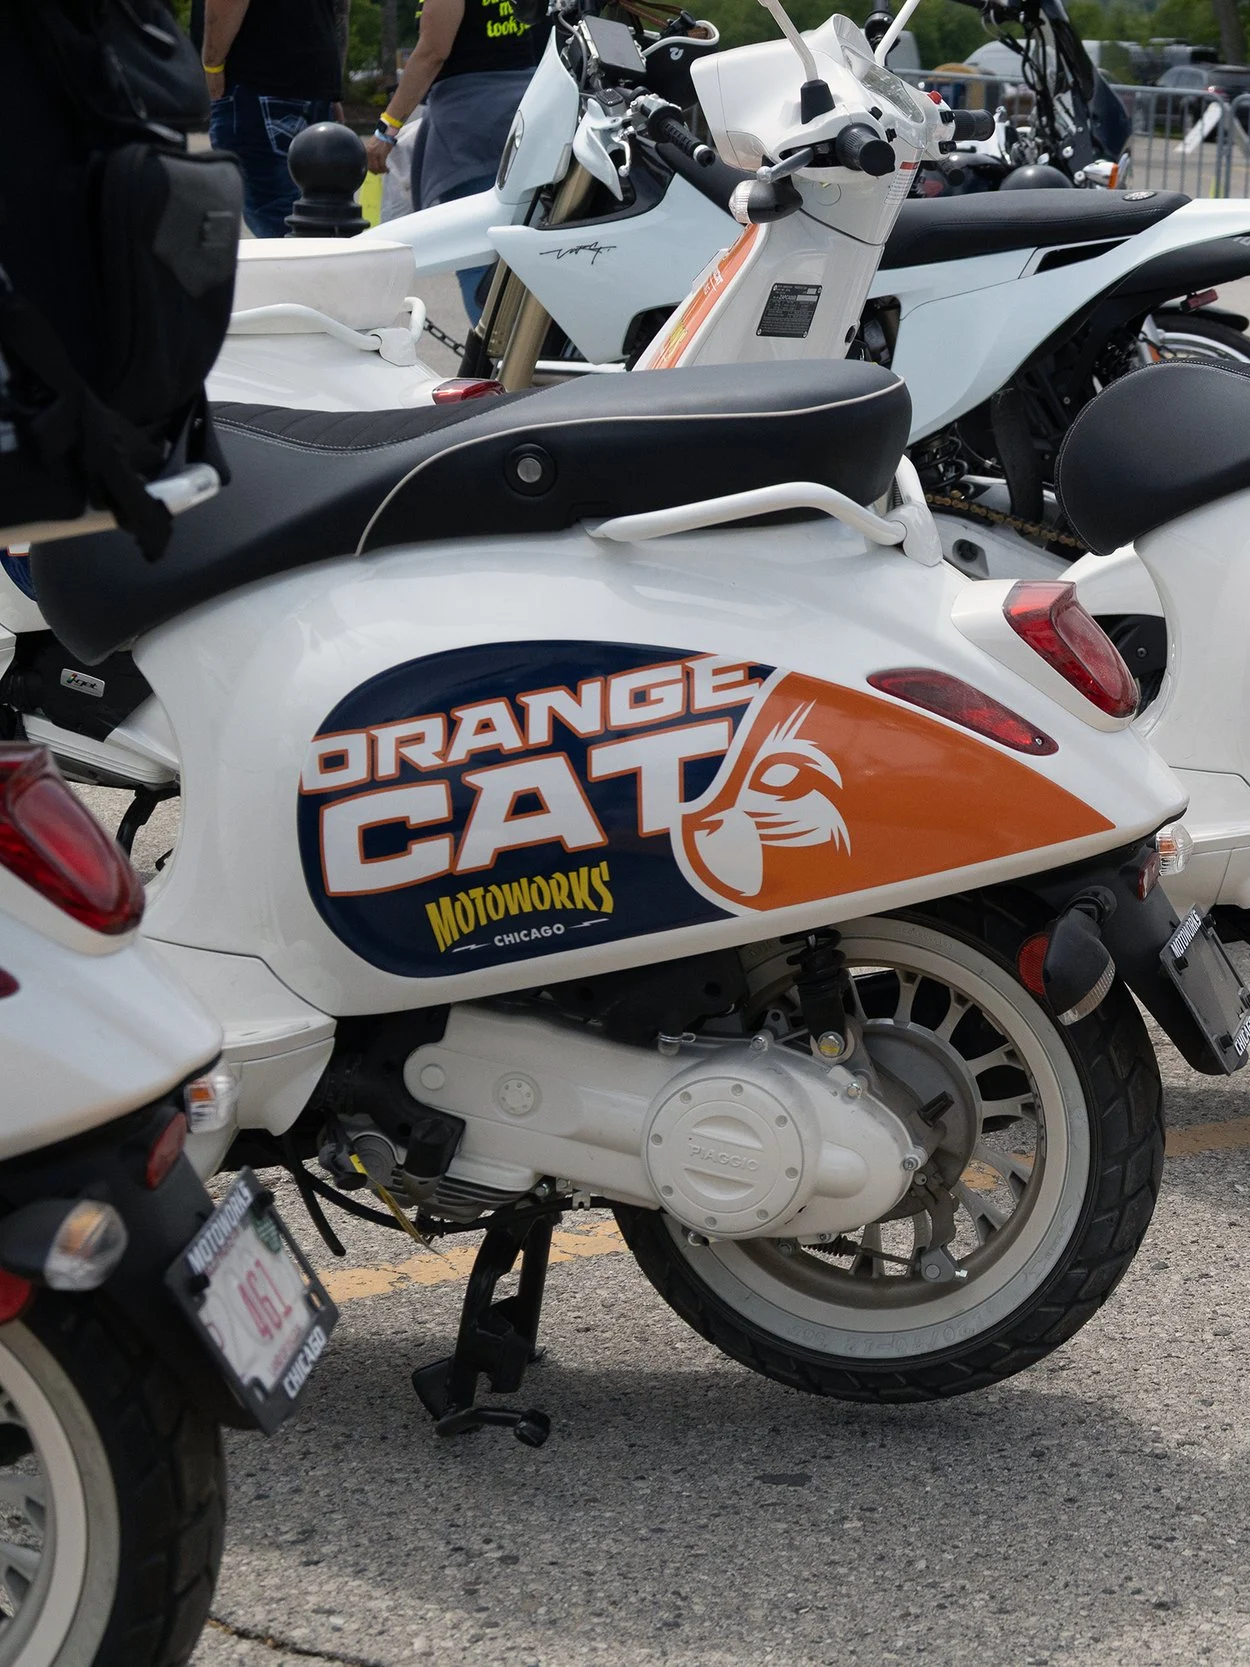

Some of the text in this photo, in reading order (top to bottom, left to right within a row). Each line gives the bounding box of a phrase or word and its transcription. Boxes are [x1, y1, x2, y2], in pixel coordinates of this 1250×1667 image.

[299, 654, 763, 795] ORANGE
[319, 717, 733, 897] CAT
[425, 861, 614, 953] MOTOWORKS
[493, 922, 566, 948] CHICAGO
[1170, 910, 1202, 958] MOTOWORKS
[688, 1143, 759, 1172] PIAGGIO
[186, 1180, 252, 1275] MOTOWORKS
[283, 1325, 328, 1400] CHICAGO
